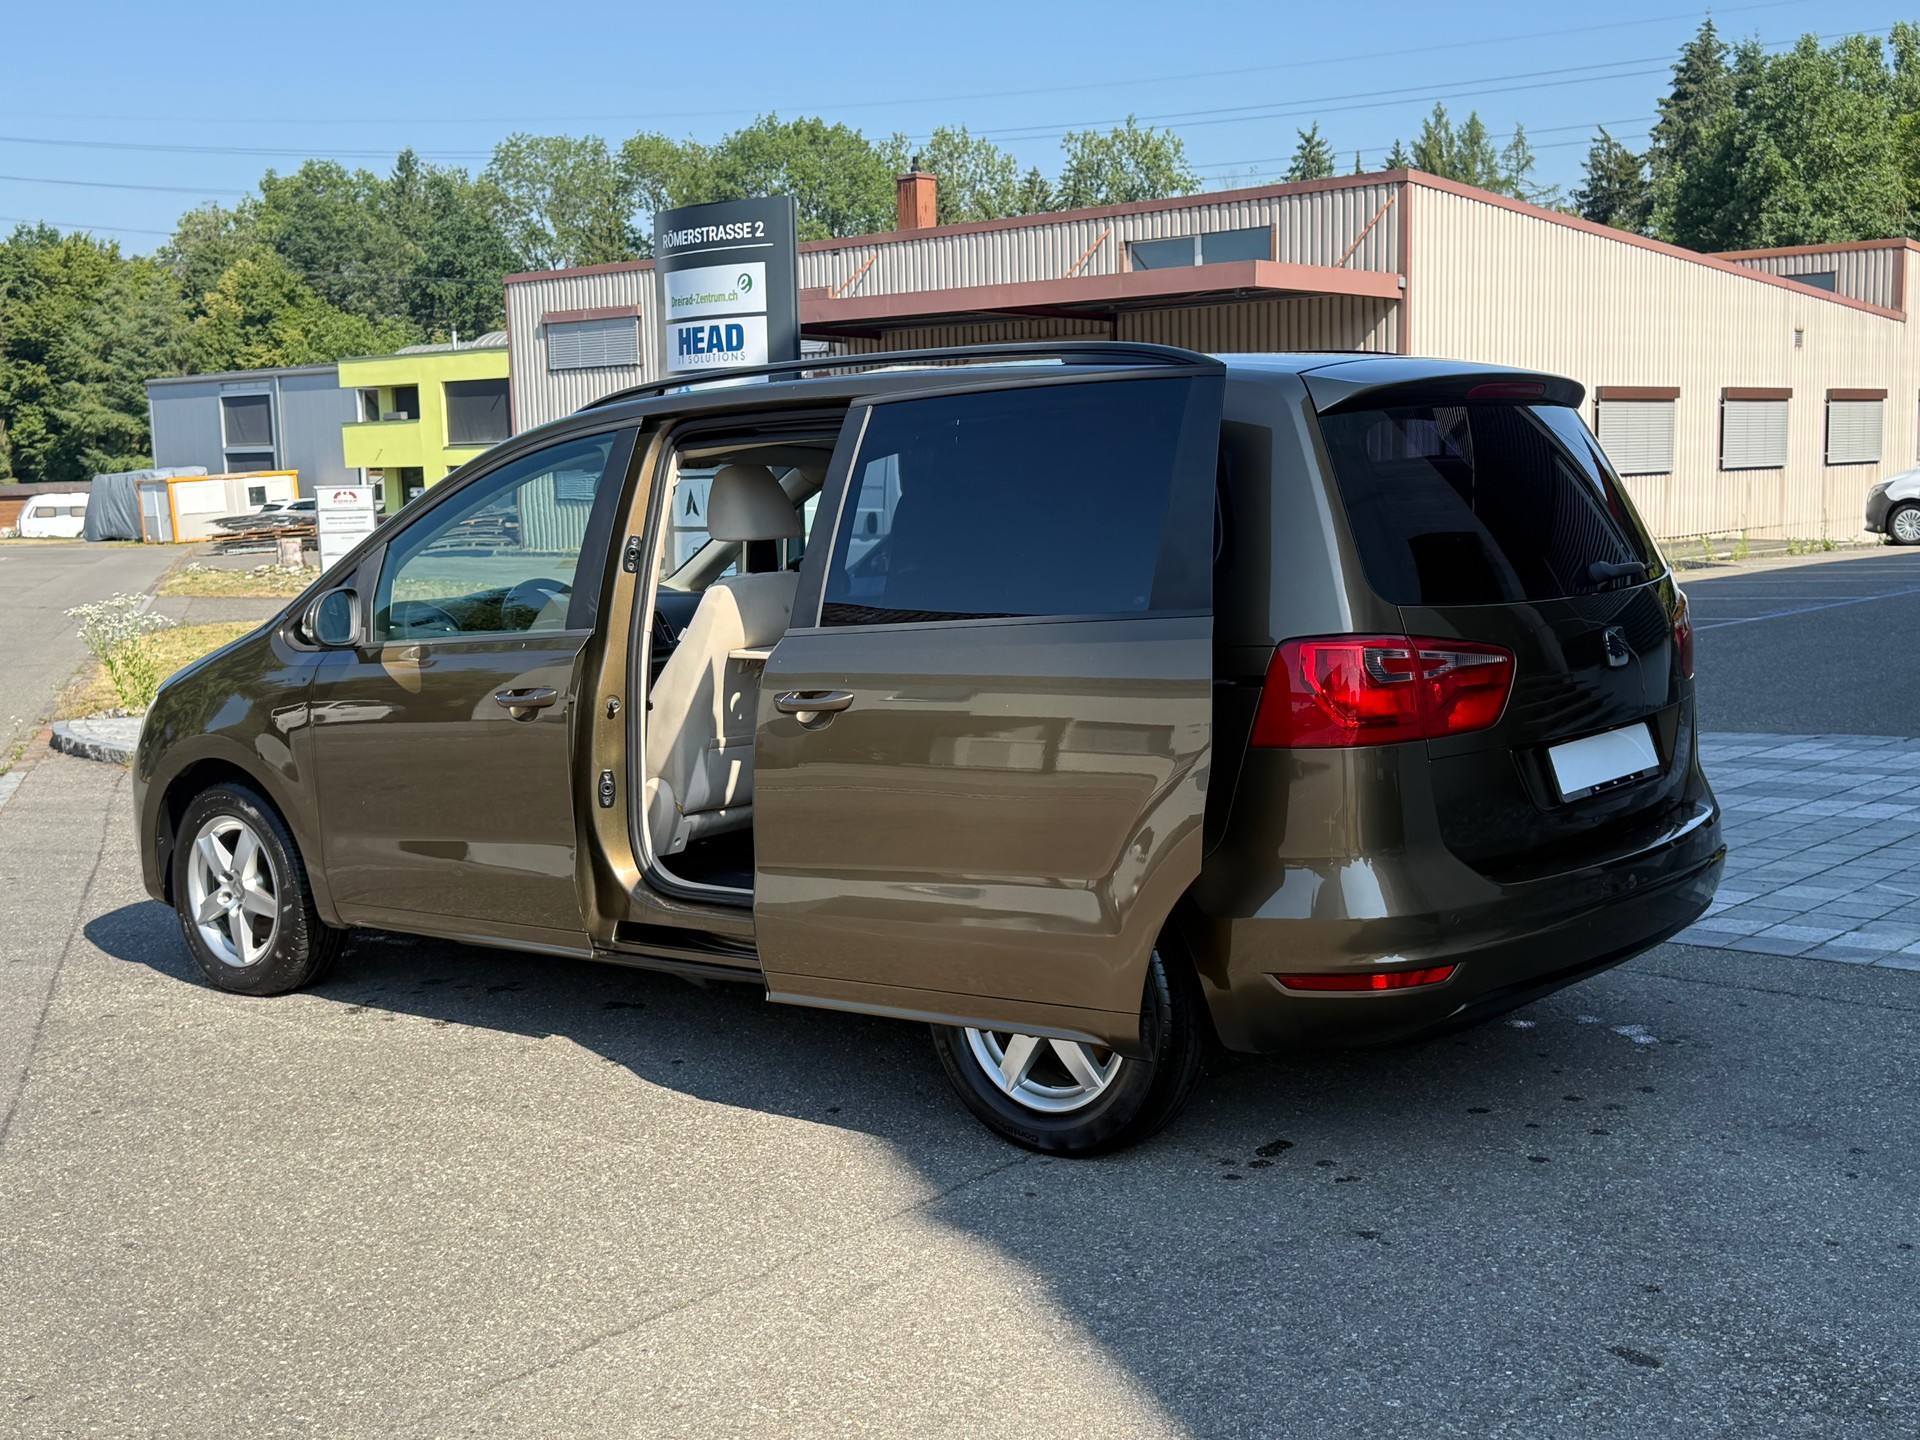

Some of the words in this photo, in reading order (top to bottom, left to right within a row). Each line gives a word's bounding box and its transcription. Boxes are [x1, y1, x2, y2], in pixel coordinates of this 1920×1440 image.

[662, 222, 752, 249] RÖMERSTRASSE
[755, 221, 765, 237] 2
[671, 290, 739, 308] Dreirad-Zentrum.ch
[678, 323, 745, 356] HEAD
[678, 355, 685, 365] IT
[688, 350, 746, 364] SOLUTIONS
